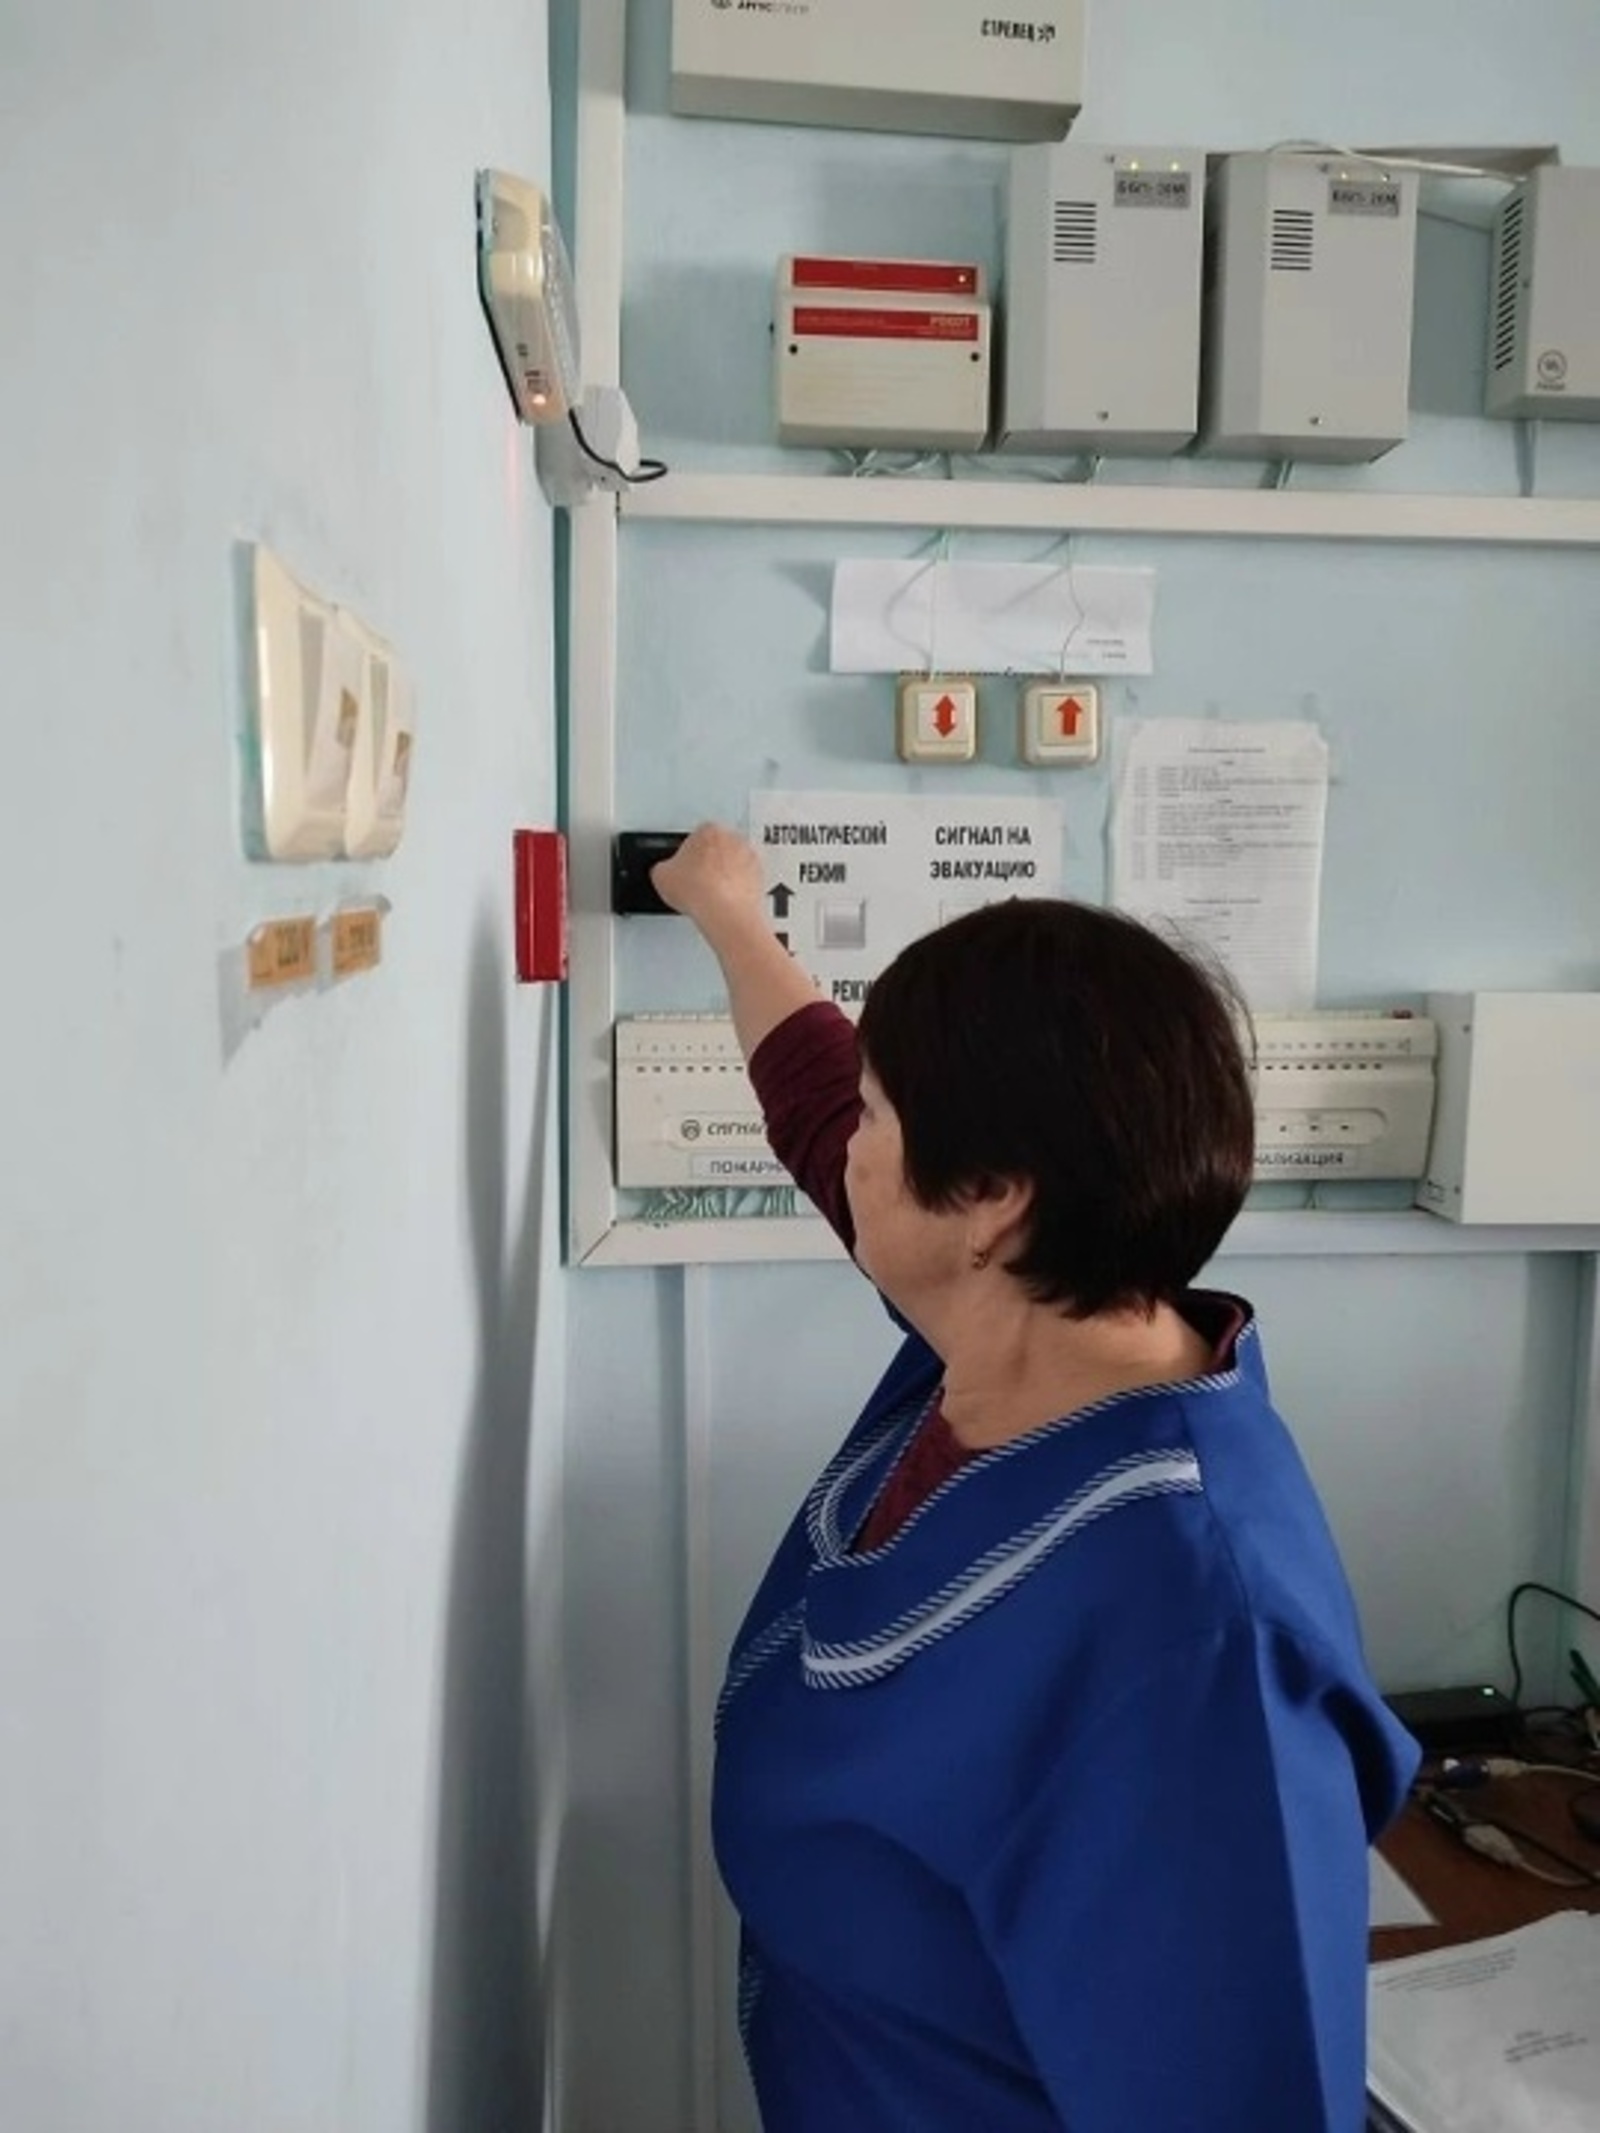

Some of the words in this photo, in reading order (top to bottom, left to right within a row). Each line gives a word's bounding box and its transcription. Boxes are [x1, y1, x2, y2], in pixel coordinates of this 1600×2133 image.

[764, 820, 887, 846] АВТОМАТИЧЕСКИЙ
[935, 826, 1002, 846] СИГНАЛ
[1007, 826, 1032, 846] НА
[930, 860, 1036, 883] ЭВАКУАЦИЮ
